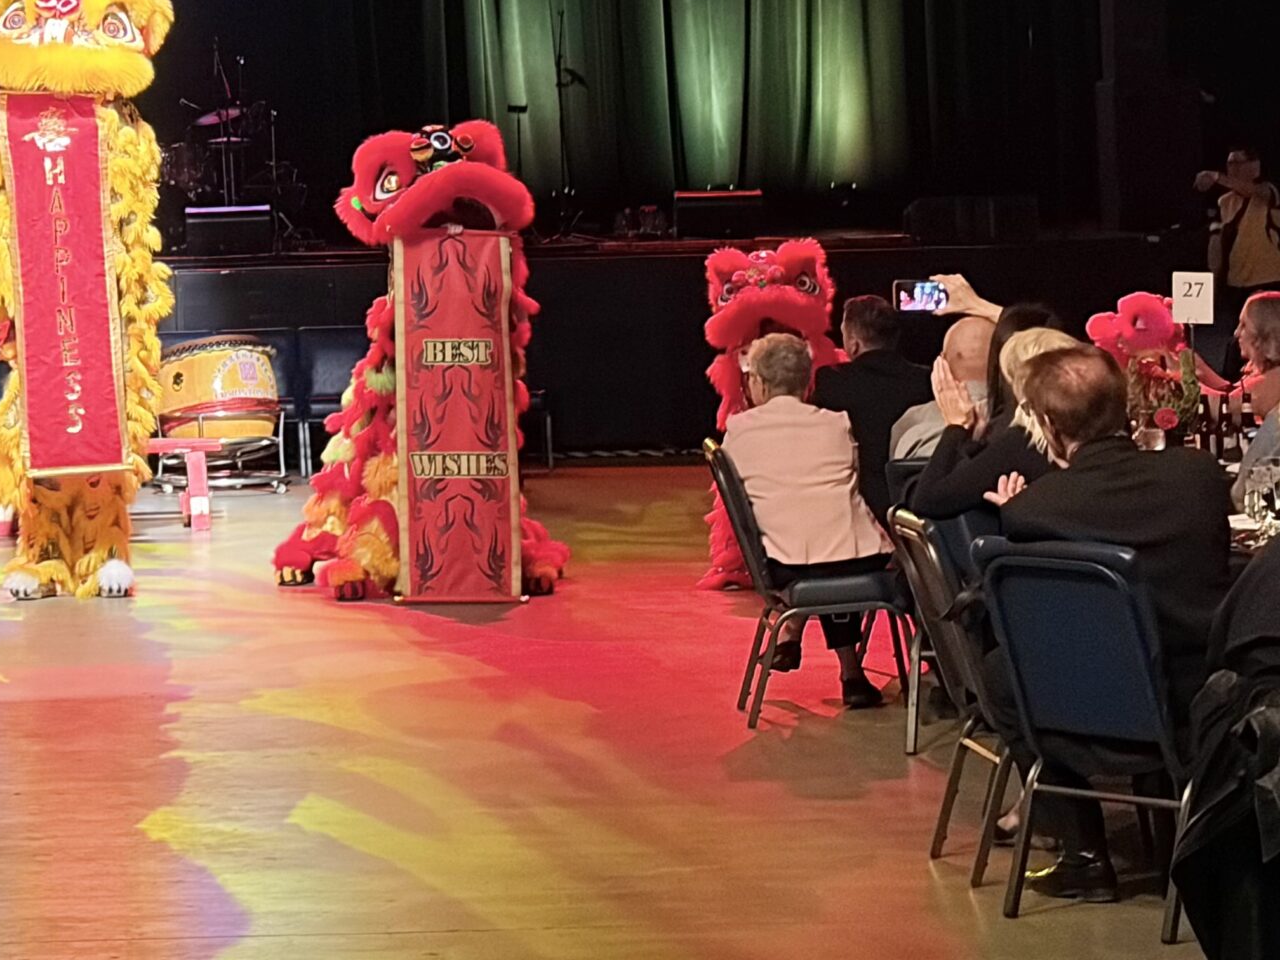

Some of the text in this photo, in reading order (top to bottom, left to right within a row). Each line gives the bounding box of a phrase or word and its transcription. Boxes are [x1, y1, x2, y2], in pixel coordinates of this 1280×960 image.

[42, 155, 86, 434] HAPPINESS
[1182, 281, 1204, 298] 27
[424, 339, 492, 364] BEST
[411, 452, 510, 478] WISHES
